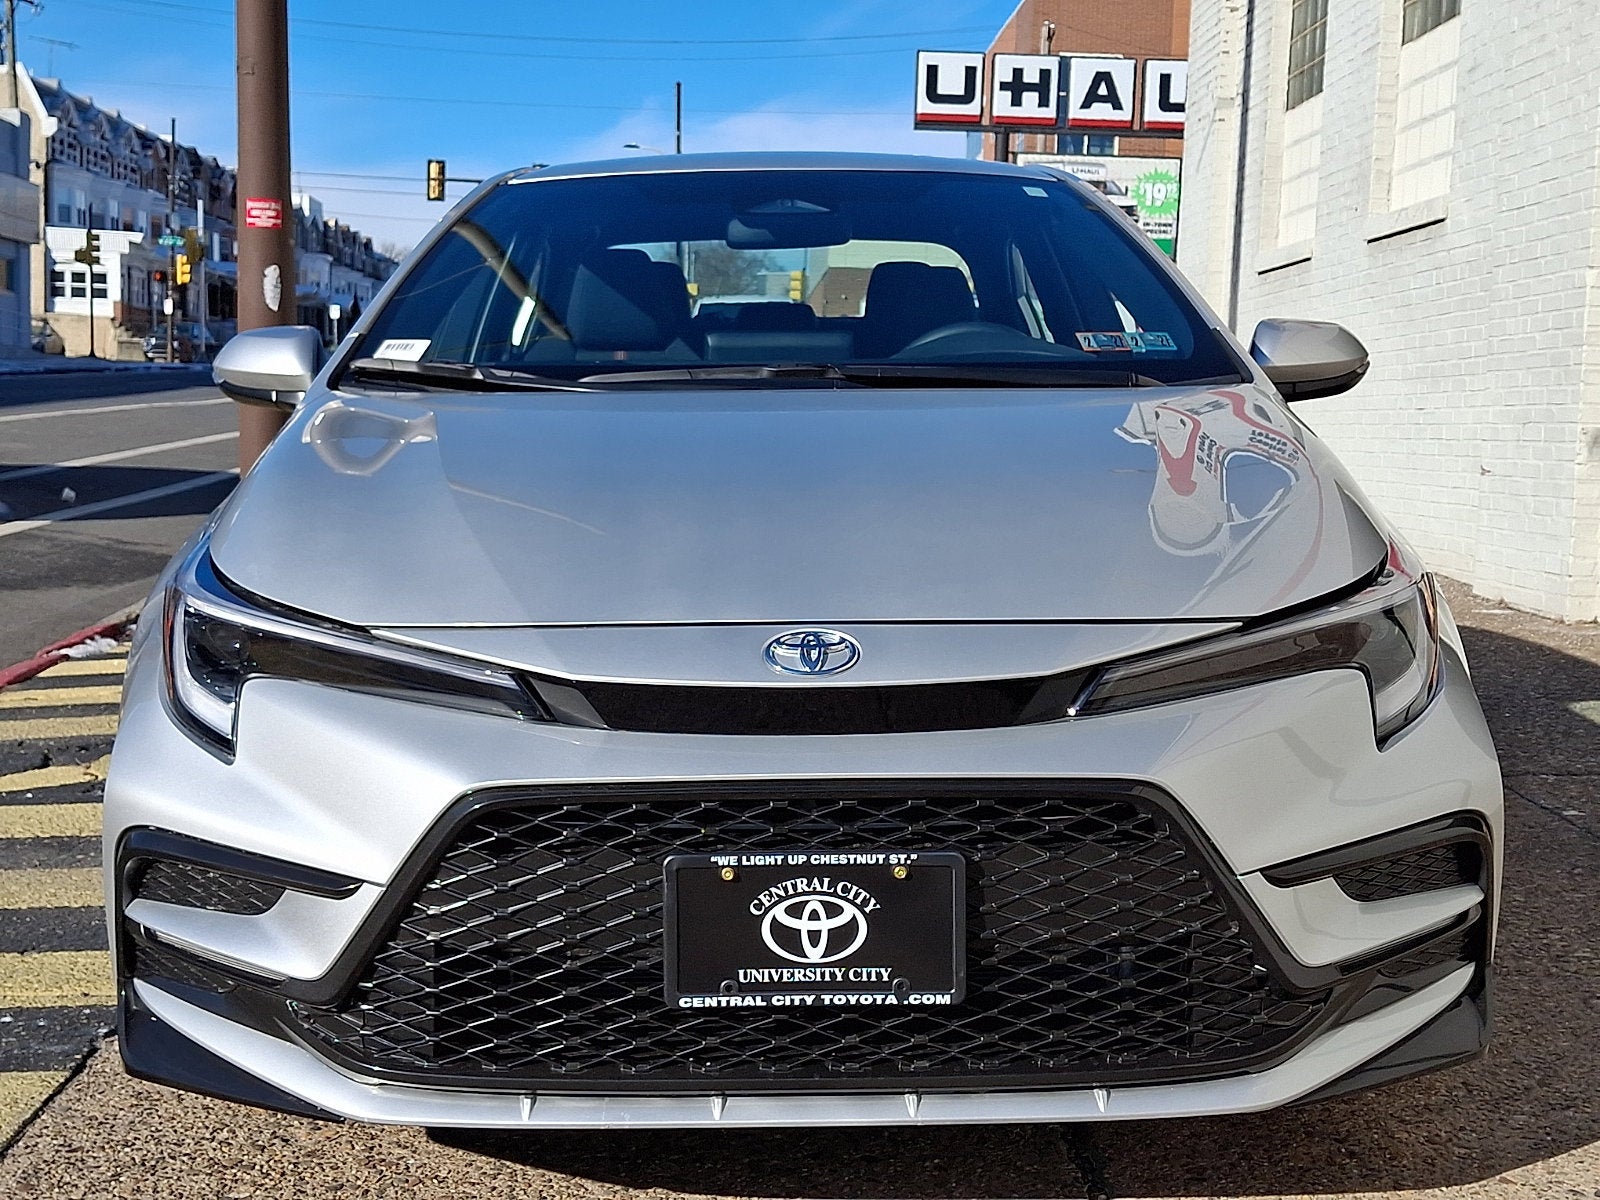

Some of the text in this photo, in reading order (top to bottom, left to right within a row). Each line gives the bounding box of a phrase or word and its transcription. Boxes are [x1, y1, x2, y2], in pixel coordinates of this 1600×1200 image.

[741, 855, 785, 865] LIGHT
[787, 855, 807, 865] UP
[809, 854, 886, 865] CHESTNUT
[749, 876, 882, 916] CENTRAL CITY
[737, 967, 893, 984] UNIVERSITY CITY
[678, 994, 952, 1008] CENTRAL CITY TOYOTA .COM
